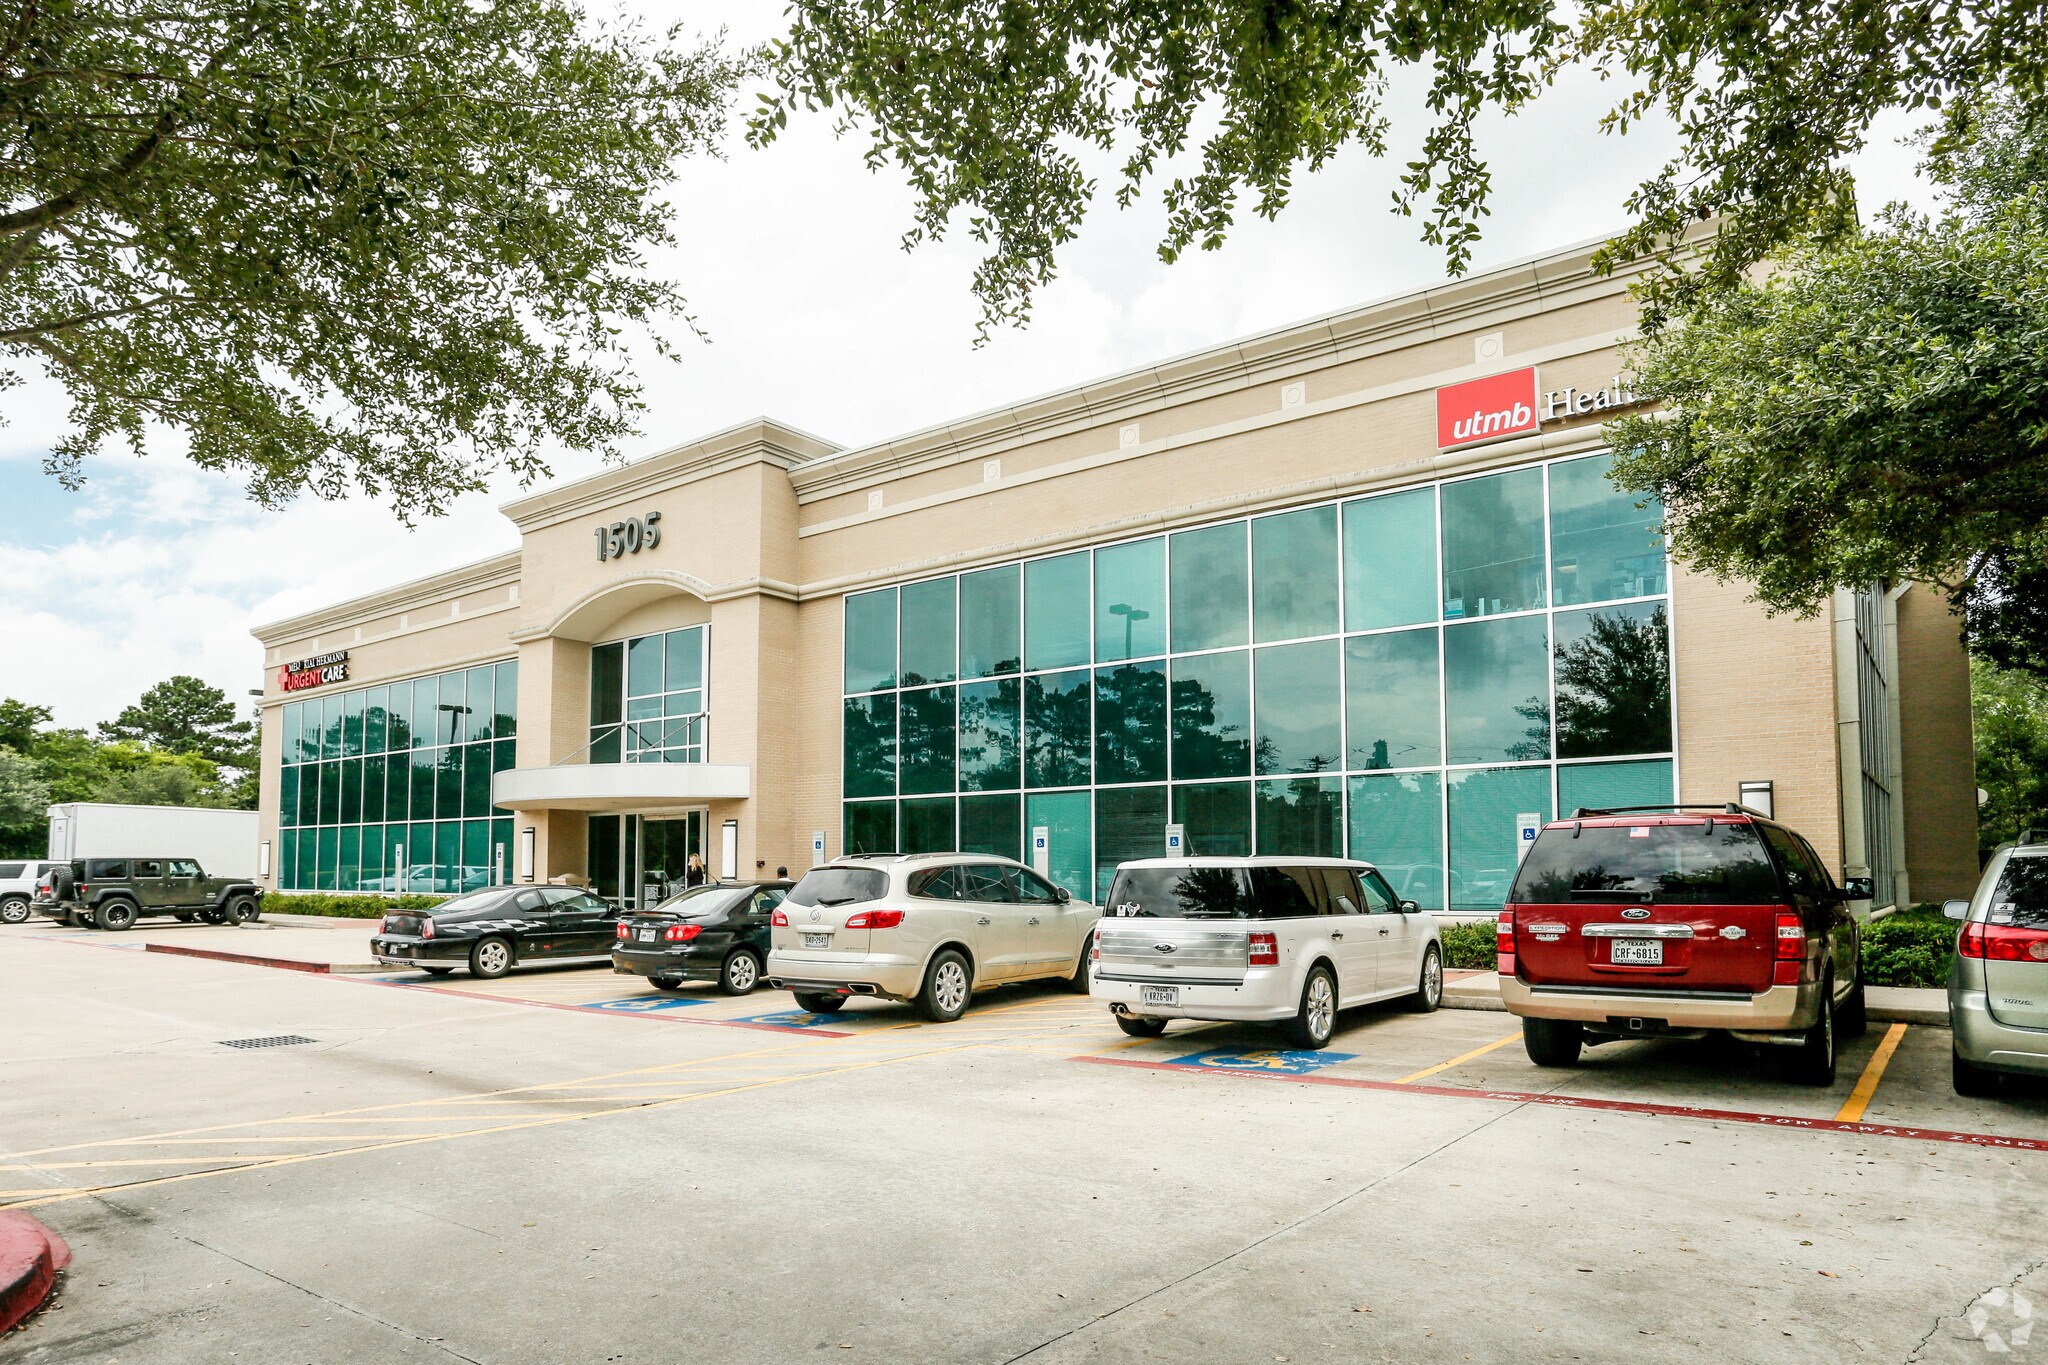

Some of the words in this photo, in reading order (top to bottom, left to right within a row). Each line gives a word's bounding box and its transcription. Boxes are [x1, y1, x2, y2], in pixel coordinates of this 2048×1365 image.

[1544, 375, 1640, 420] Healt
[1453, 401, 1531, 440] utmb
[594, 511, 661, 562] 1505
[316, 651, 345, 665] HERMANN
[288, 670, 322, 690] URGENT
[321, 664, 344, 683] CARE
[1533, 1096, 1581, 1106] LANE
[1757, 1116, 1813, 1126] TOW
[1837, 1124, 1919, 1137] AWAY
